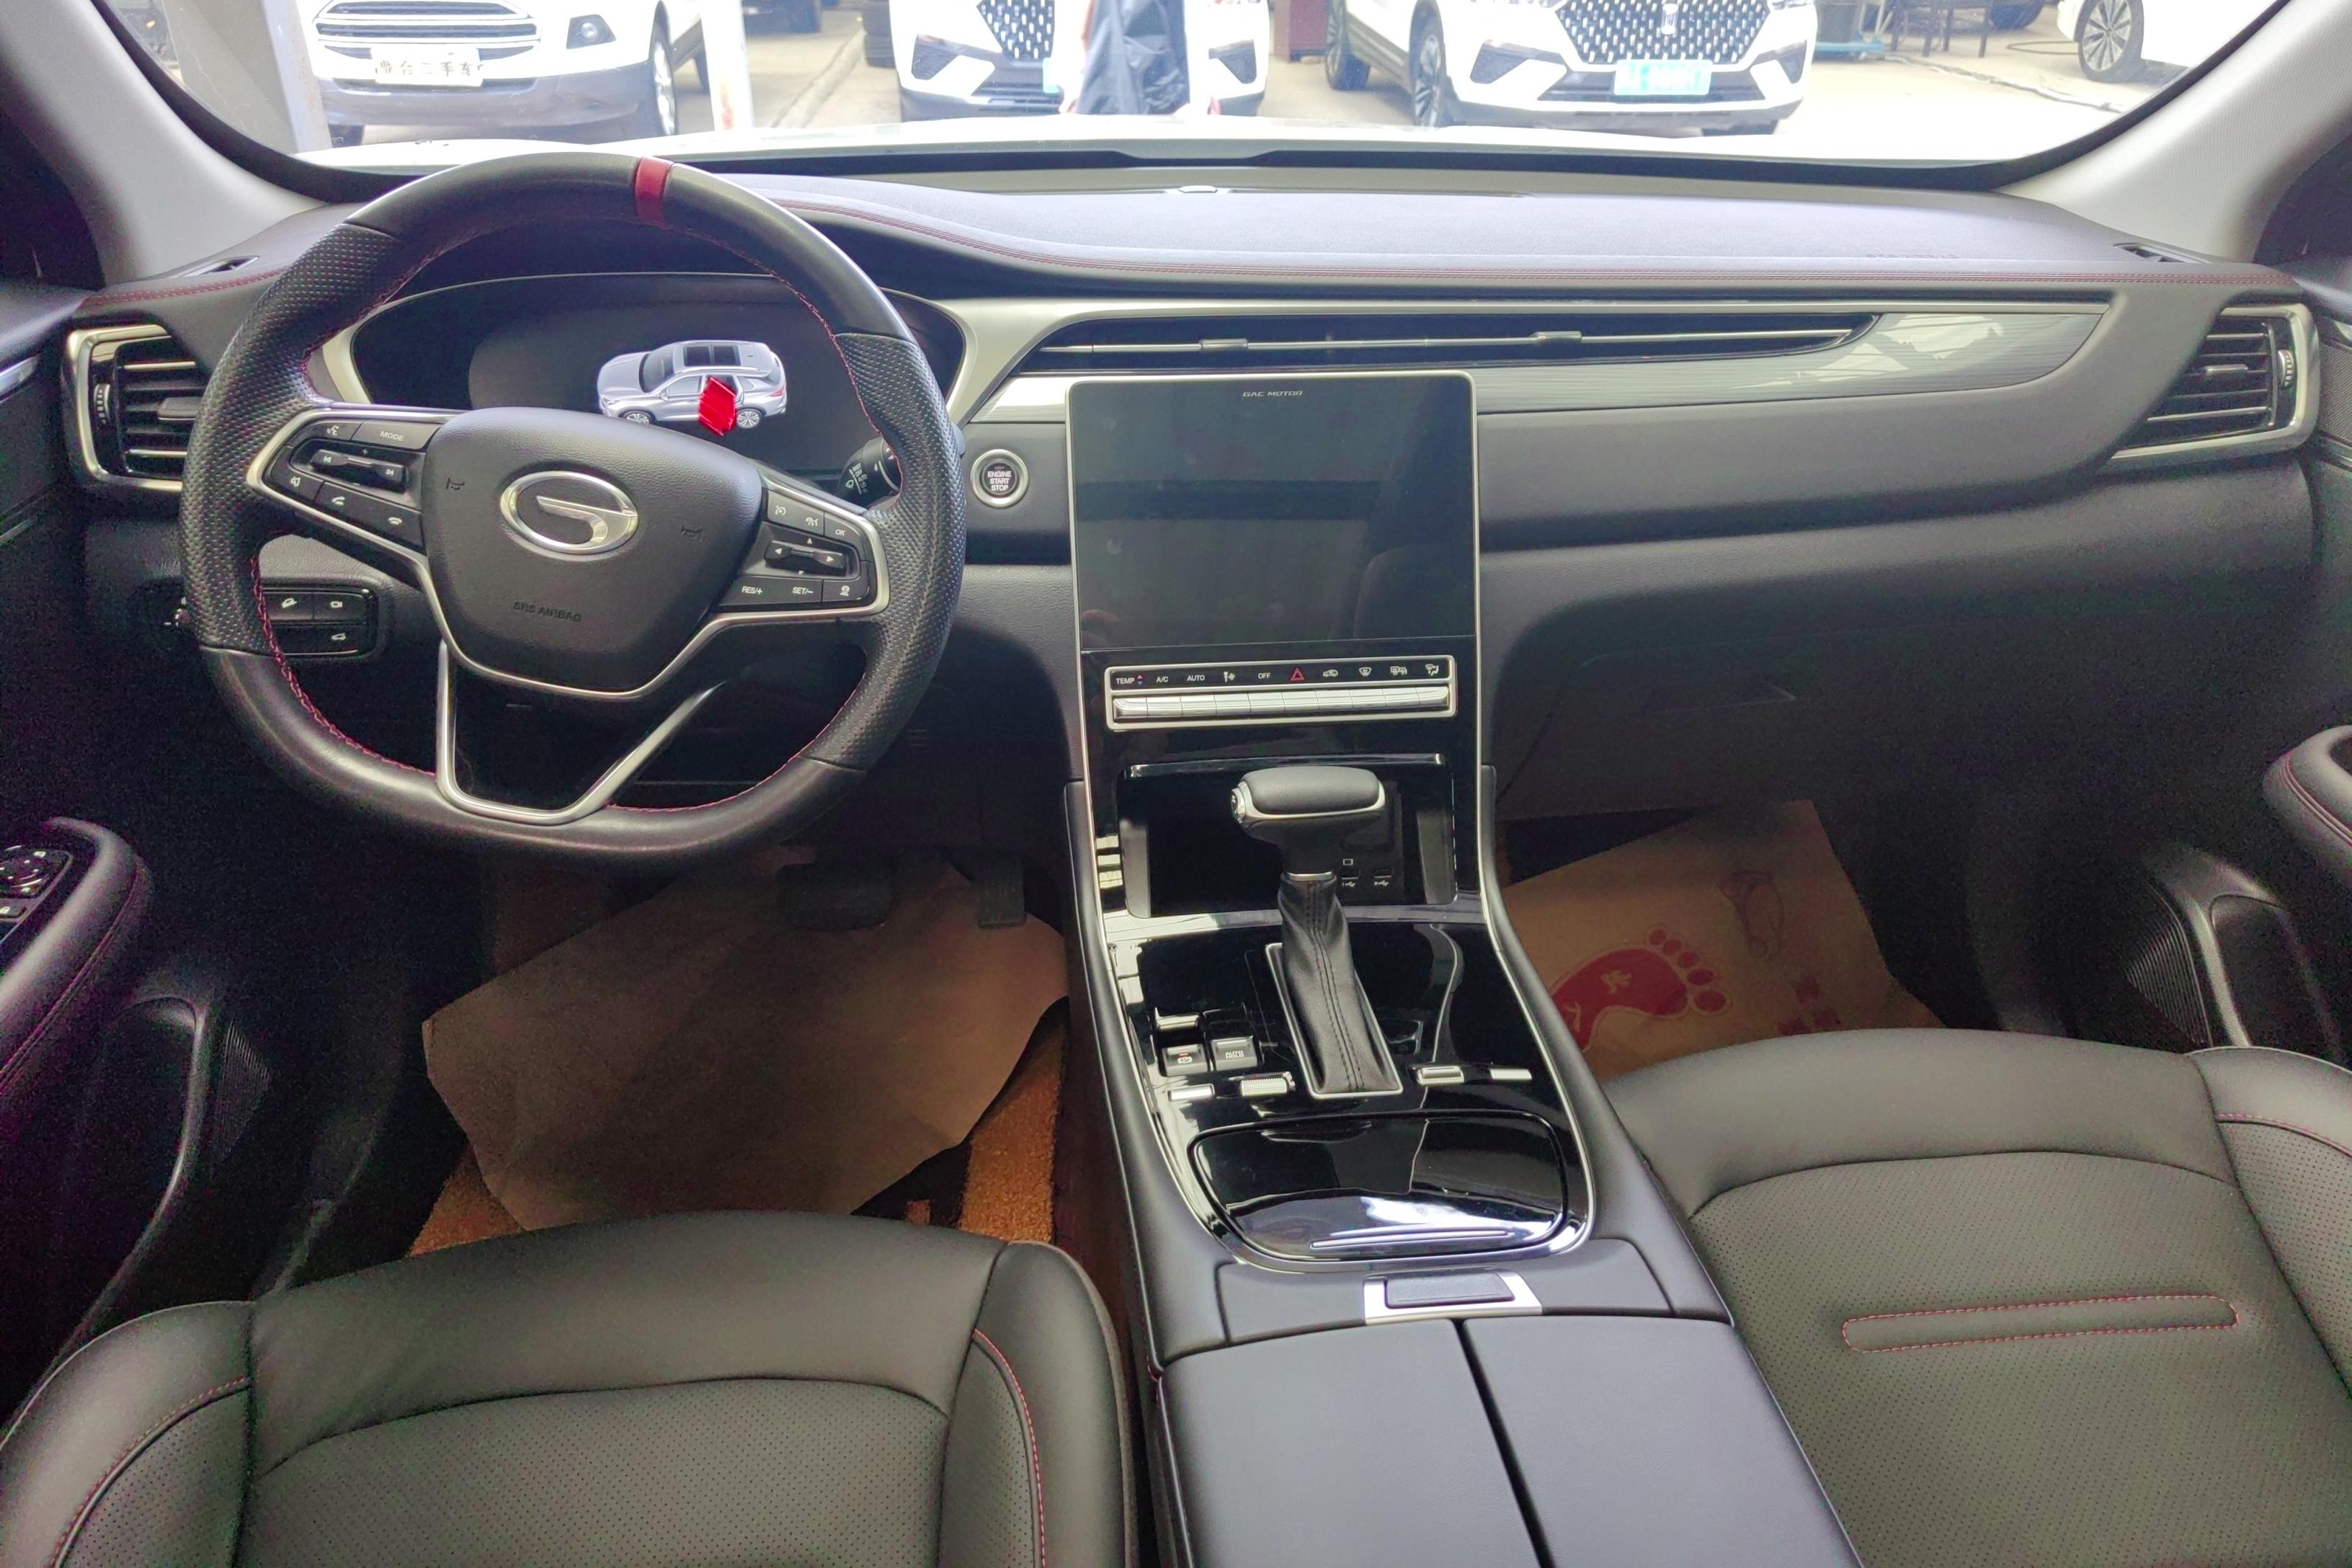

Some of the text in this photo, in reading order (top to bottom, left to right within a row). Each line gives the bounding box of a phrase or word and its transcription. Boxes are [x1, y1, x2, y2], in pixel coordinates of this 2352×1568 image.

[380, 430, 404, 442] MODE
[513, 602, 582, 623] SRS AIRBAG
